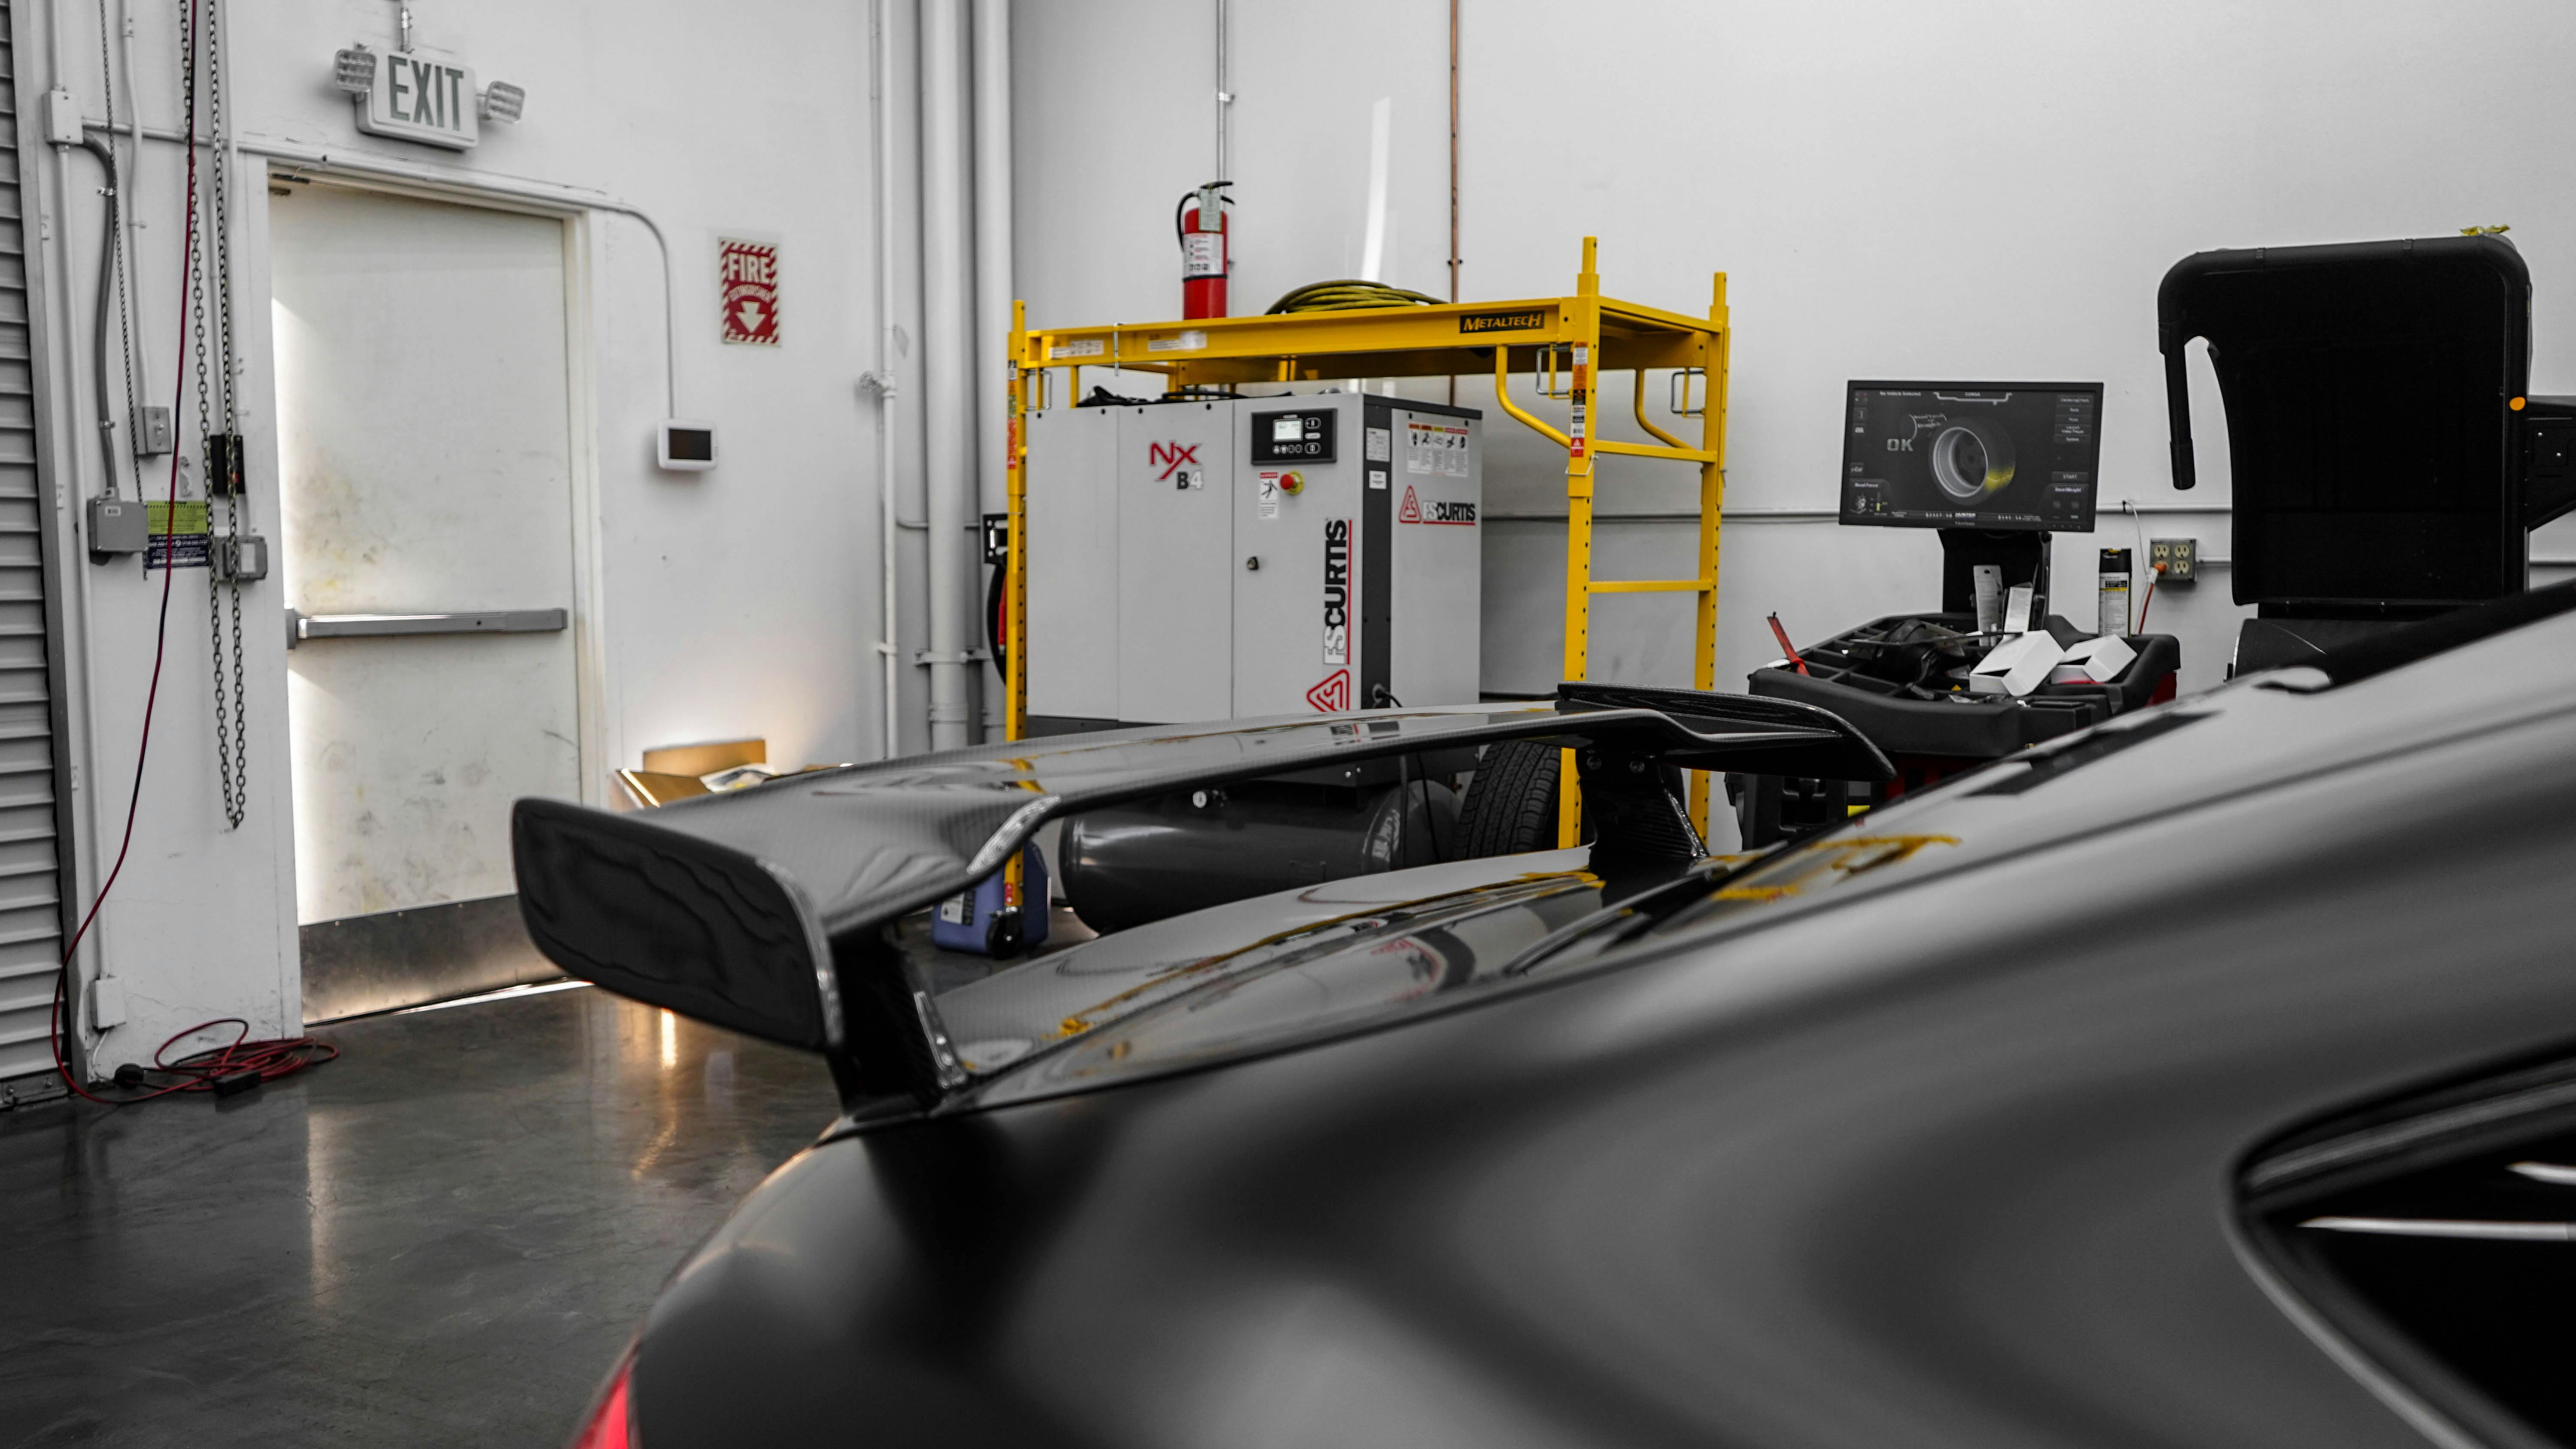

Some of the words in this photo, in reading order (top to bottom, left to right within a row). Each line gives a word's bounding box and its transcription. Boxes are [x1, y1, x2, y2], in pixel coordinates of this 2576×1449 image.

[389, 55, 464, 131] EXIT
[727, 252, 771, 283] FIRE
[1887, 439, 1914, 452] OK
[1177, 470, 1203, 490] B4
[1422, 500, 1476, 521] FSCURTIS
[1323, 519, 1347, 665] FSCURTIS
